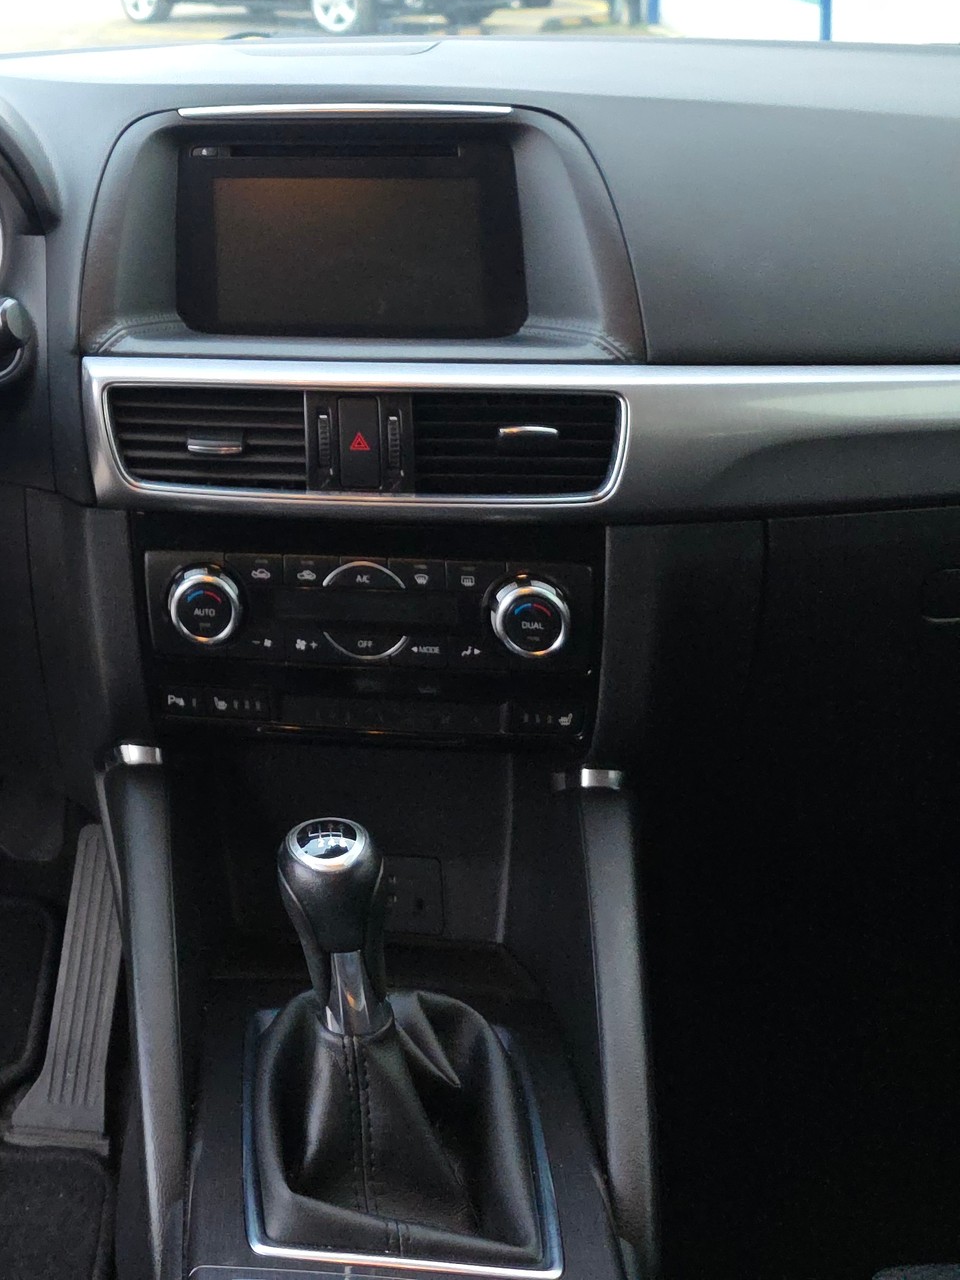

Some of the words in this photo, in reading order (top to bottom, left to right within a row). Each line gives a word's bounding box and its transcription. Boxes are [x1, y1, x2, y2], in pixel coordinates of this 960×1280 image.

[355, 574, 370, 584] A/C
[193, 608, 216, 617] AUTO
[521, 621, 544, 630] DUAL
[357, 640, 373, 648] OFF
[418, 646, 440, 654] MODE
